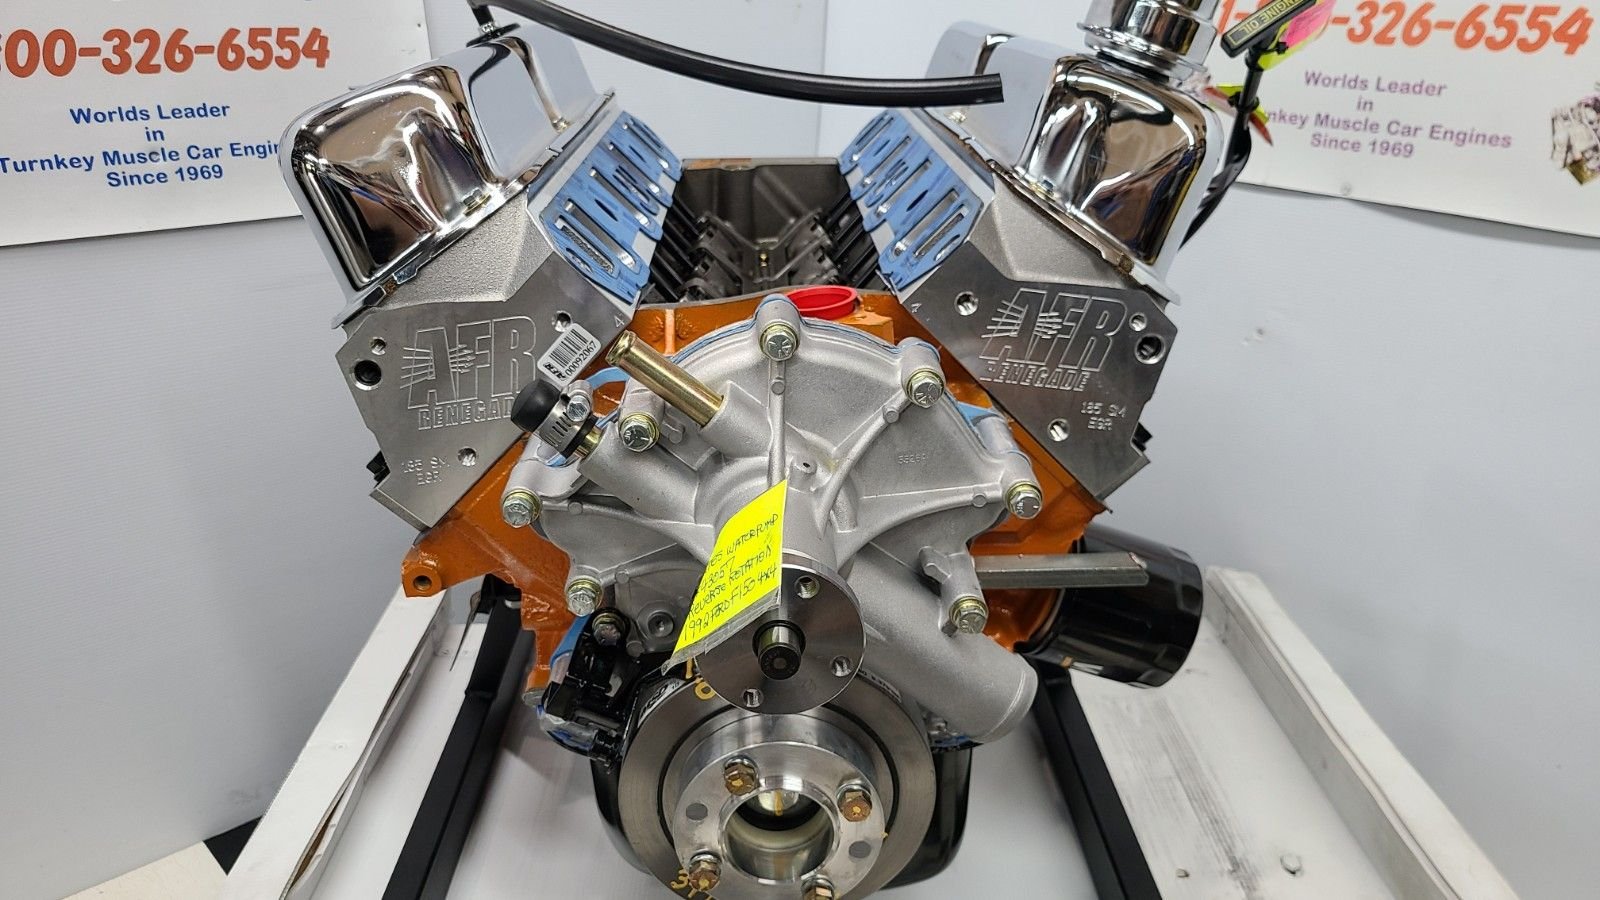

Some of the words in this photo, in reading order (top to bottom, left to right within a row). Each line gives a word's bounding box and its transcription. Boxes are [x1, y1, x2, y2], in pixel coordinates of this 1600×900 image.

[1240, 20, 1260, 35] OIL
[0, 27, 330, 78] 00-326-6554
[1304, 69, 1368, 91] Worlds
[1376, 76, 1447, 96] Leader
[69, 105, 151, 124] Worlds
[157, 102, 231, 120] Leader
[1356, 95, 1374, 111] in
[145, 126, 165, 142] in
[1310, 132, 1361, 152] Since
[1368, 138, 1414, 158] 1969
[1314, 113, 1380, 134] Muscle
[1387, 120, 1422, 138] Car
[1429, 124, 1512, 149] Engines
[0, 153, 94, 173] Turnkey
[102, 147, 180, 166] Muscle
[187, 144, 223, 160] Car
[106, 170, 168, 187] Since
[175, 164, 224, 182] 1969
[979, 287, 1128, 373] AFR
[400, 315, 537, 410] AFR
[564, 340, 598, 378] 00092067
[979, 360, 1091, 392] RENEGADE
[418, 396, 515, 431] RENEGAD
